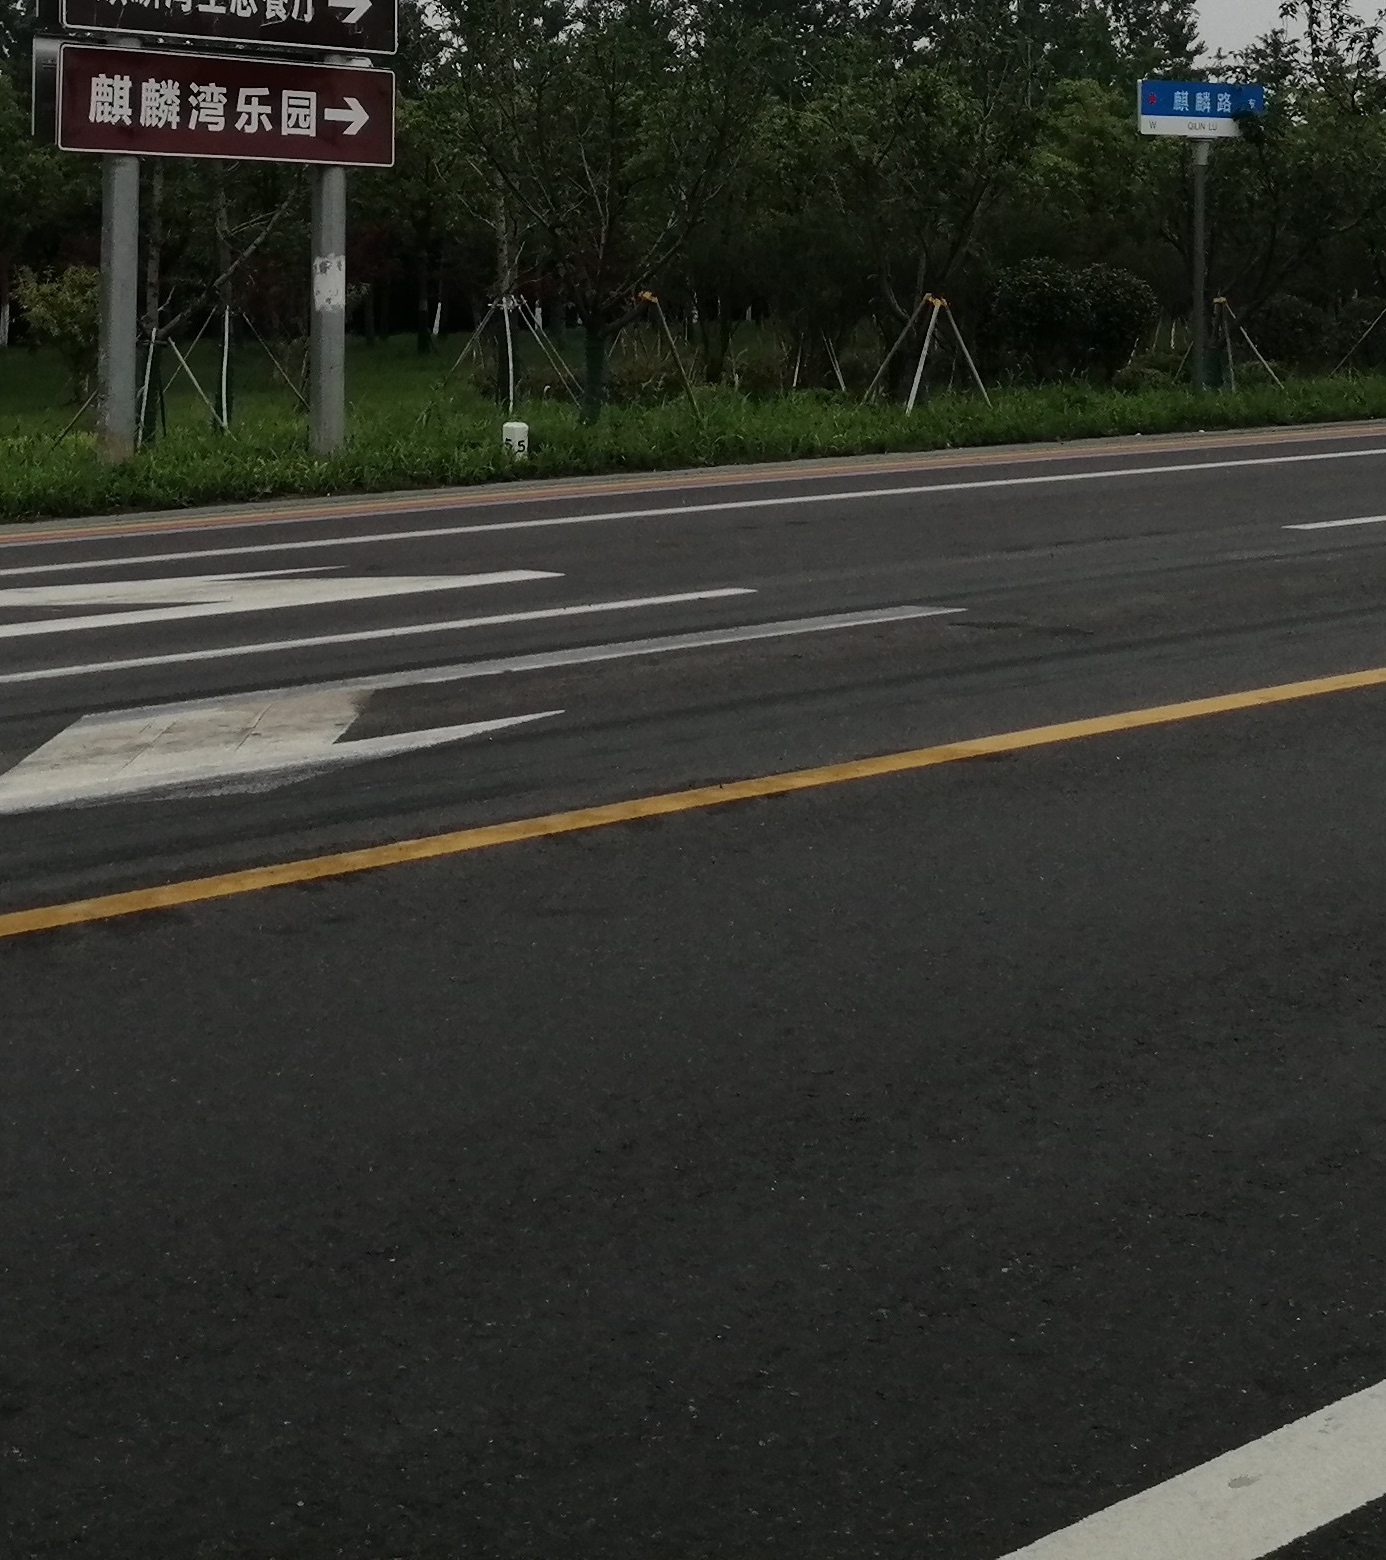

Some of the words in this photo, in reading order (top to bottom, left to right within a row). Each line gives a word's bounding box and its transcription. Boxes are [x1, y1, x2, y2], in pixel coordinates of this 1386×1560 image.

[88, 73, 317, 138] 麒麟湾乐园
[1173, 90, 1232, 113] 麒麟路
